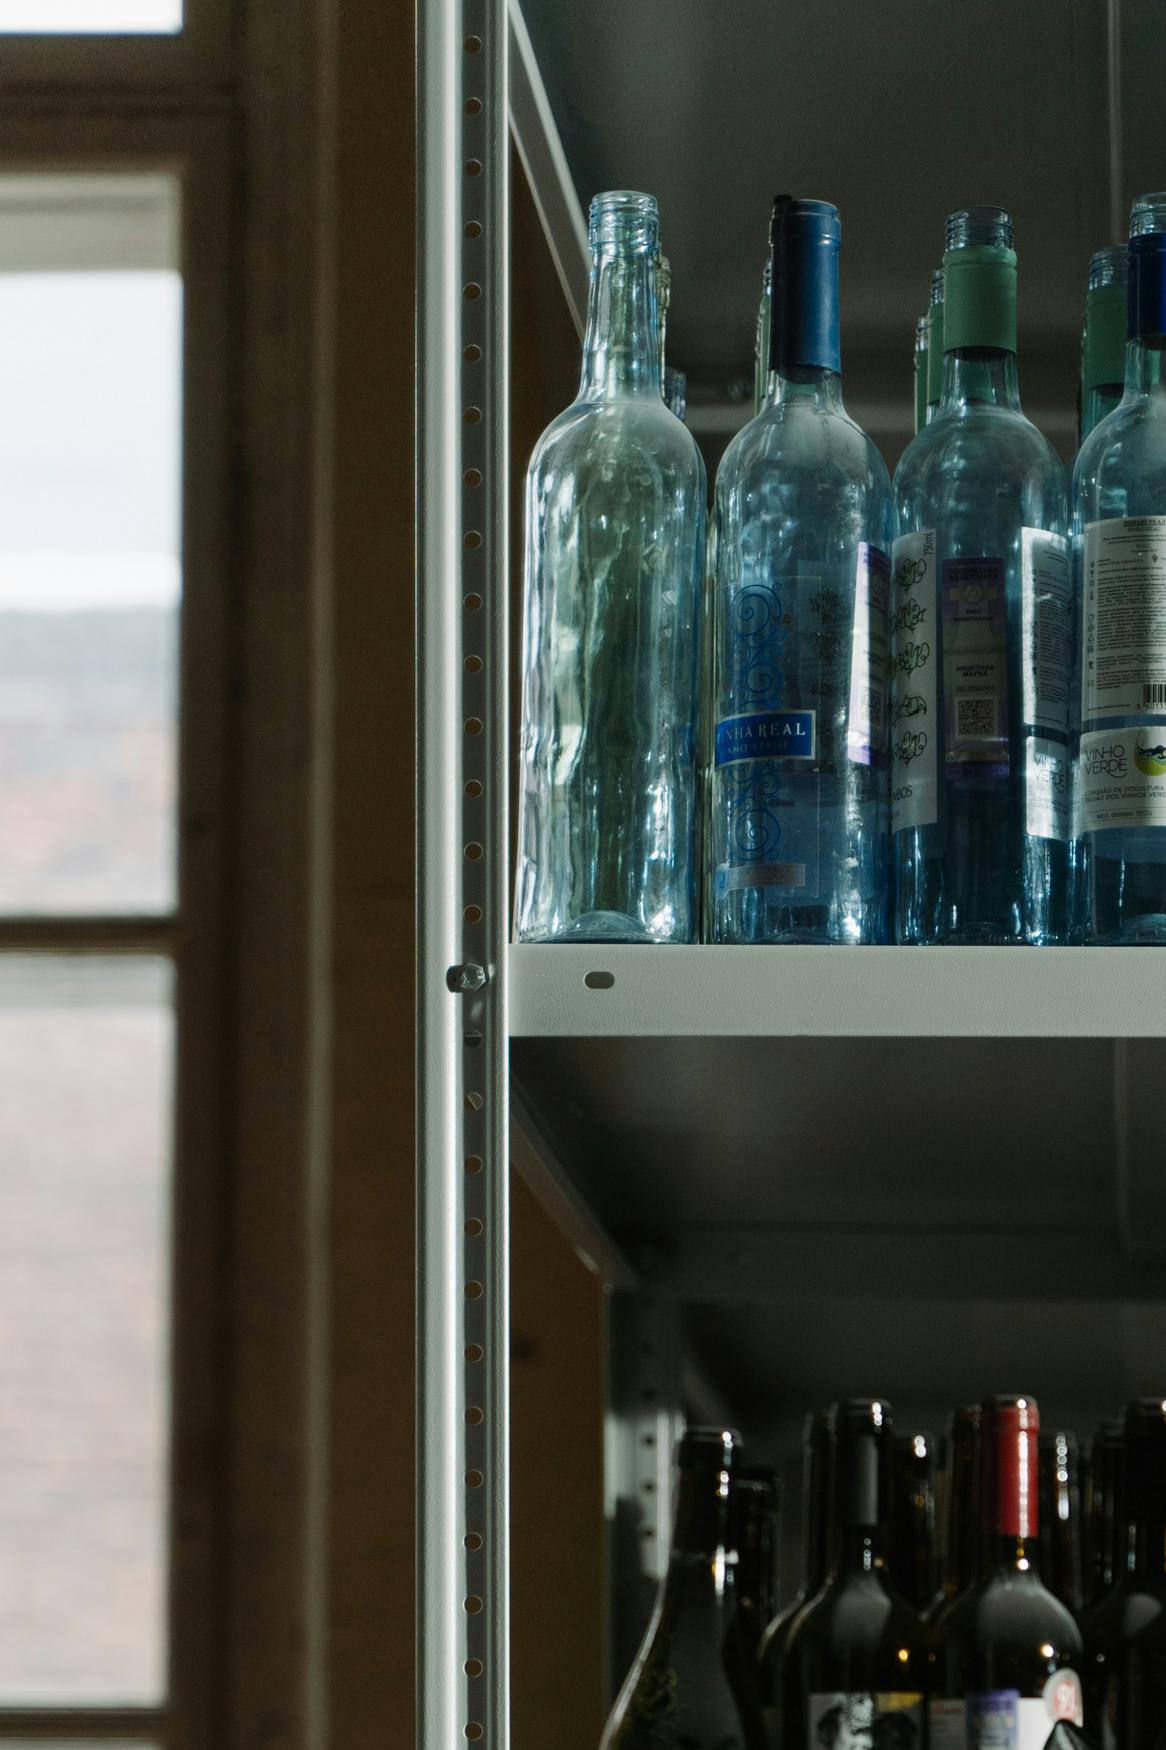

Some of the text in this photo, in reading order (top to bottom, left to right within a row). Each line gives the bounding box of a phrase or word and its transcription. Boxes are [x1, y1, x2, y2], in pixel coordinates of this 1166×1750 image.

[758, 722, 806, 737] REAL
[1085, 744, 1126, 762] VINHO
[1085, 757, 1128, 779] VERDE
